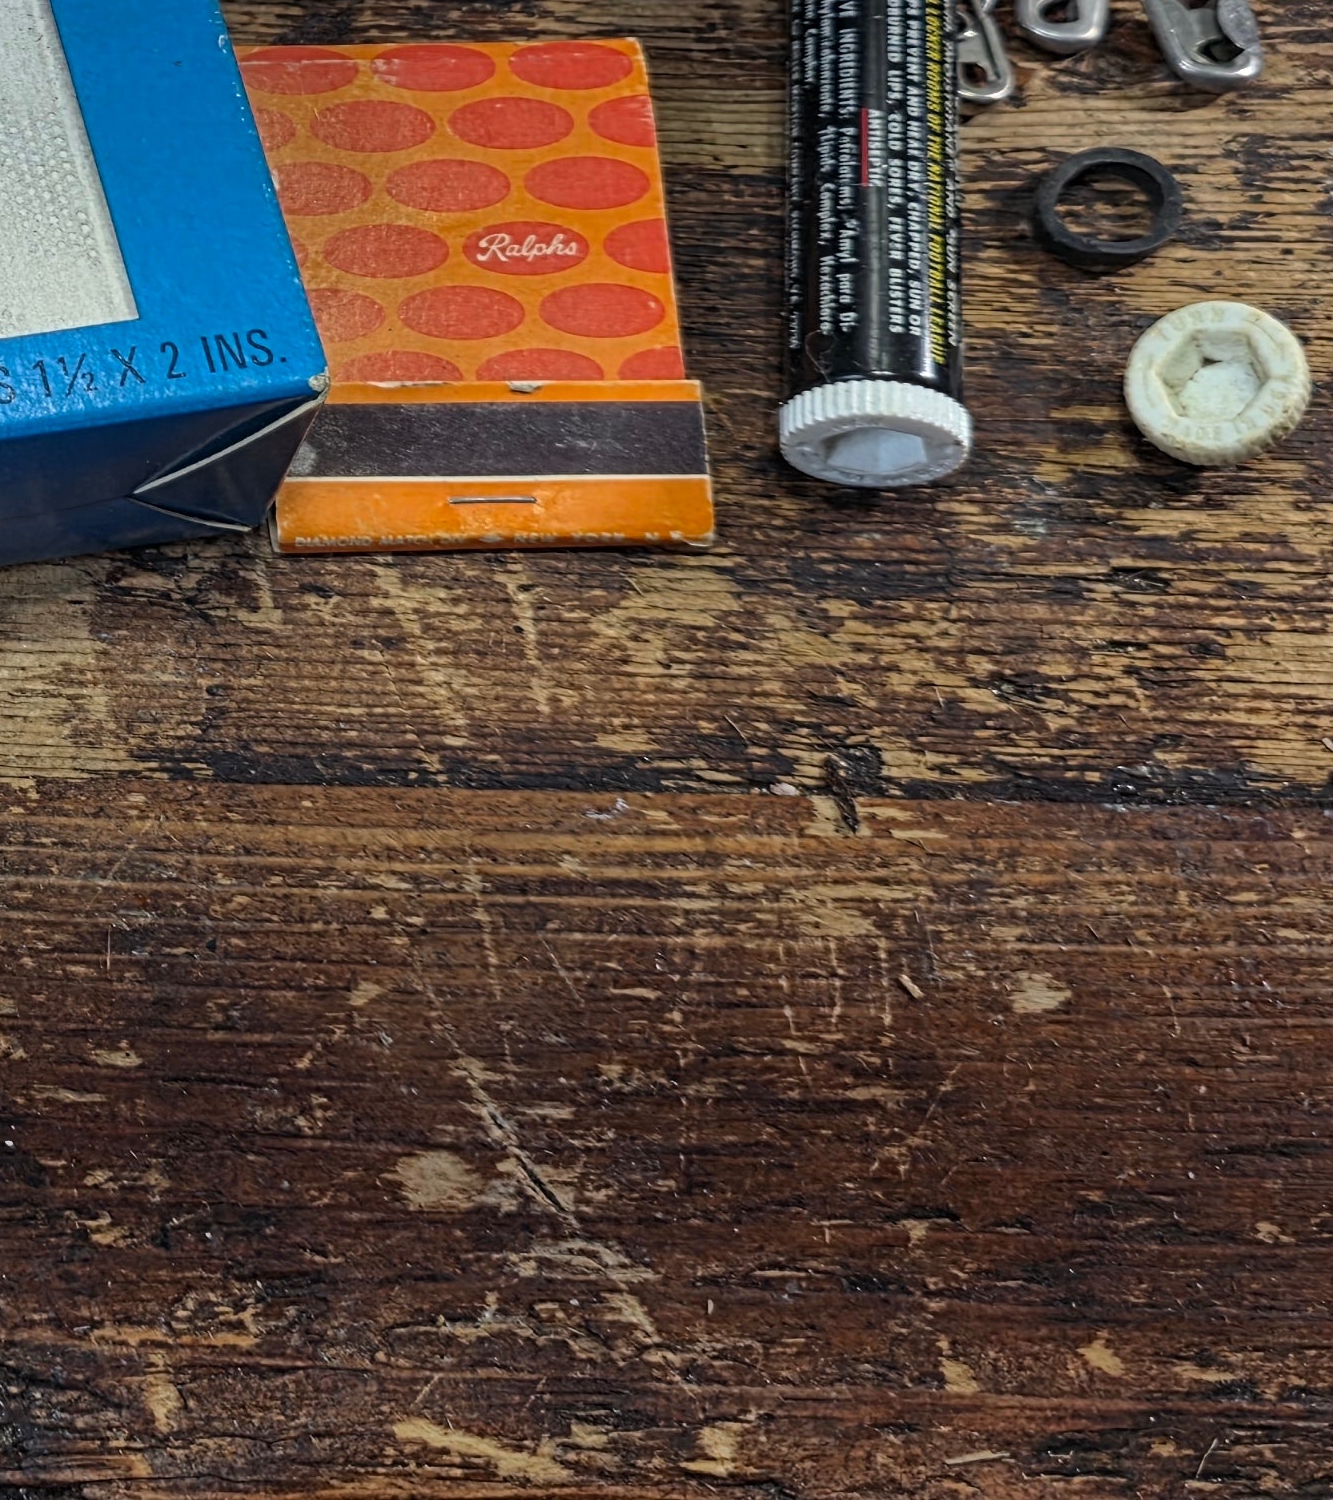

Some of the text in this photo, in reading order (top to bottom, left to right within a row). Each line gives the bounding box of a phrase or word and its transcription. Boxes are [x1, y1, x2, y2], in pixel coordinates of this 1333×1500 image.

[906, 20, 923, 81] PREVENT
[925, 8, 942, 60] LOCKER
[886, 70, 905, 104] LIPS,
[906, 85, 923, 117] AND
[926, 62, 942, 111] ROOMS
[887, 113, 905, 150] COLD
[907, 120, 924, 157] HEAL
[926, 113, 942, 132] OF
[867, 108, 886, 187] ANTISEPTIC
[927, 134, 943, 159] THE
[887, 159, 905, 209] SORES,
[927, 163, 943, 229] NATIONAL
[476, 233, 578, 262] Ralphs
[889, 217, 906, 259] FEVER
[906, 202, 923, 274] CHAPPED,
[928, 234, 944, 303] FOOTBALL
[889, 268, 905, 333] BLISTERS
[908, 280, 923, 310] SUN
[909, 314, 922, 335] OR
[928, 307, 945, 364] LEAGUE
[116, 344, 147, 388] X
[158, 340, 187, 380] 2
[202, 326, 288, 374] INS.
[295, 535, 373, 549] DIAMOND
